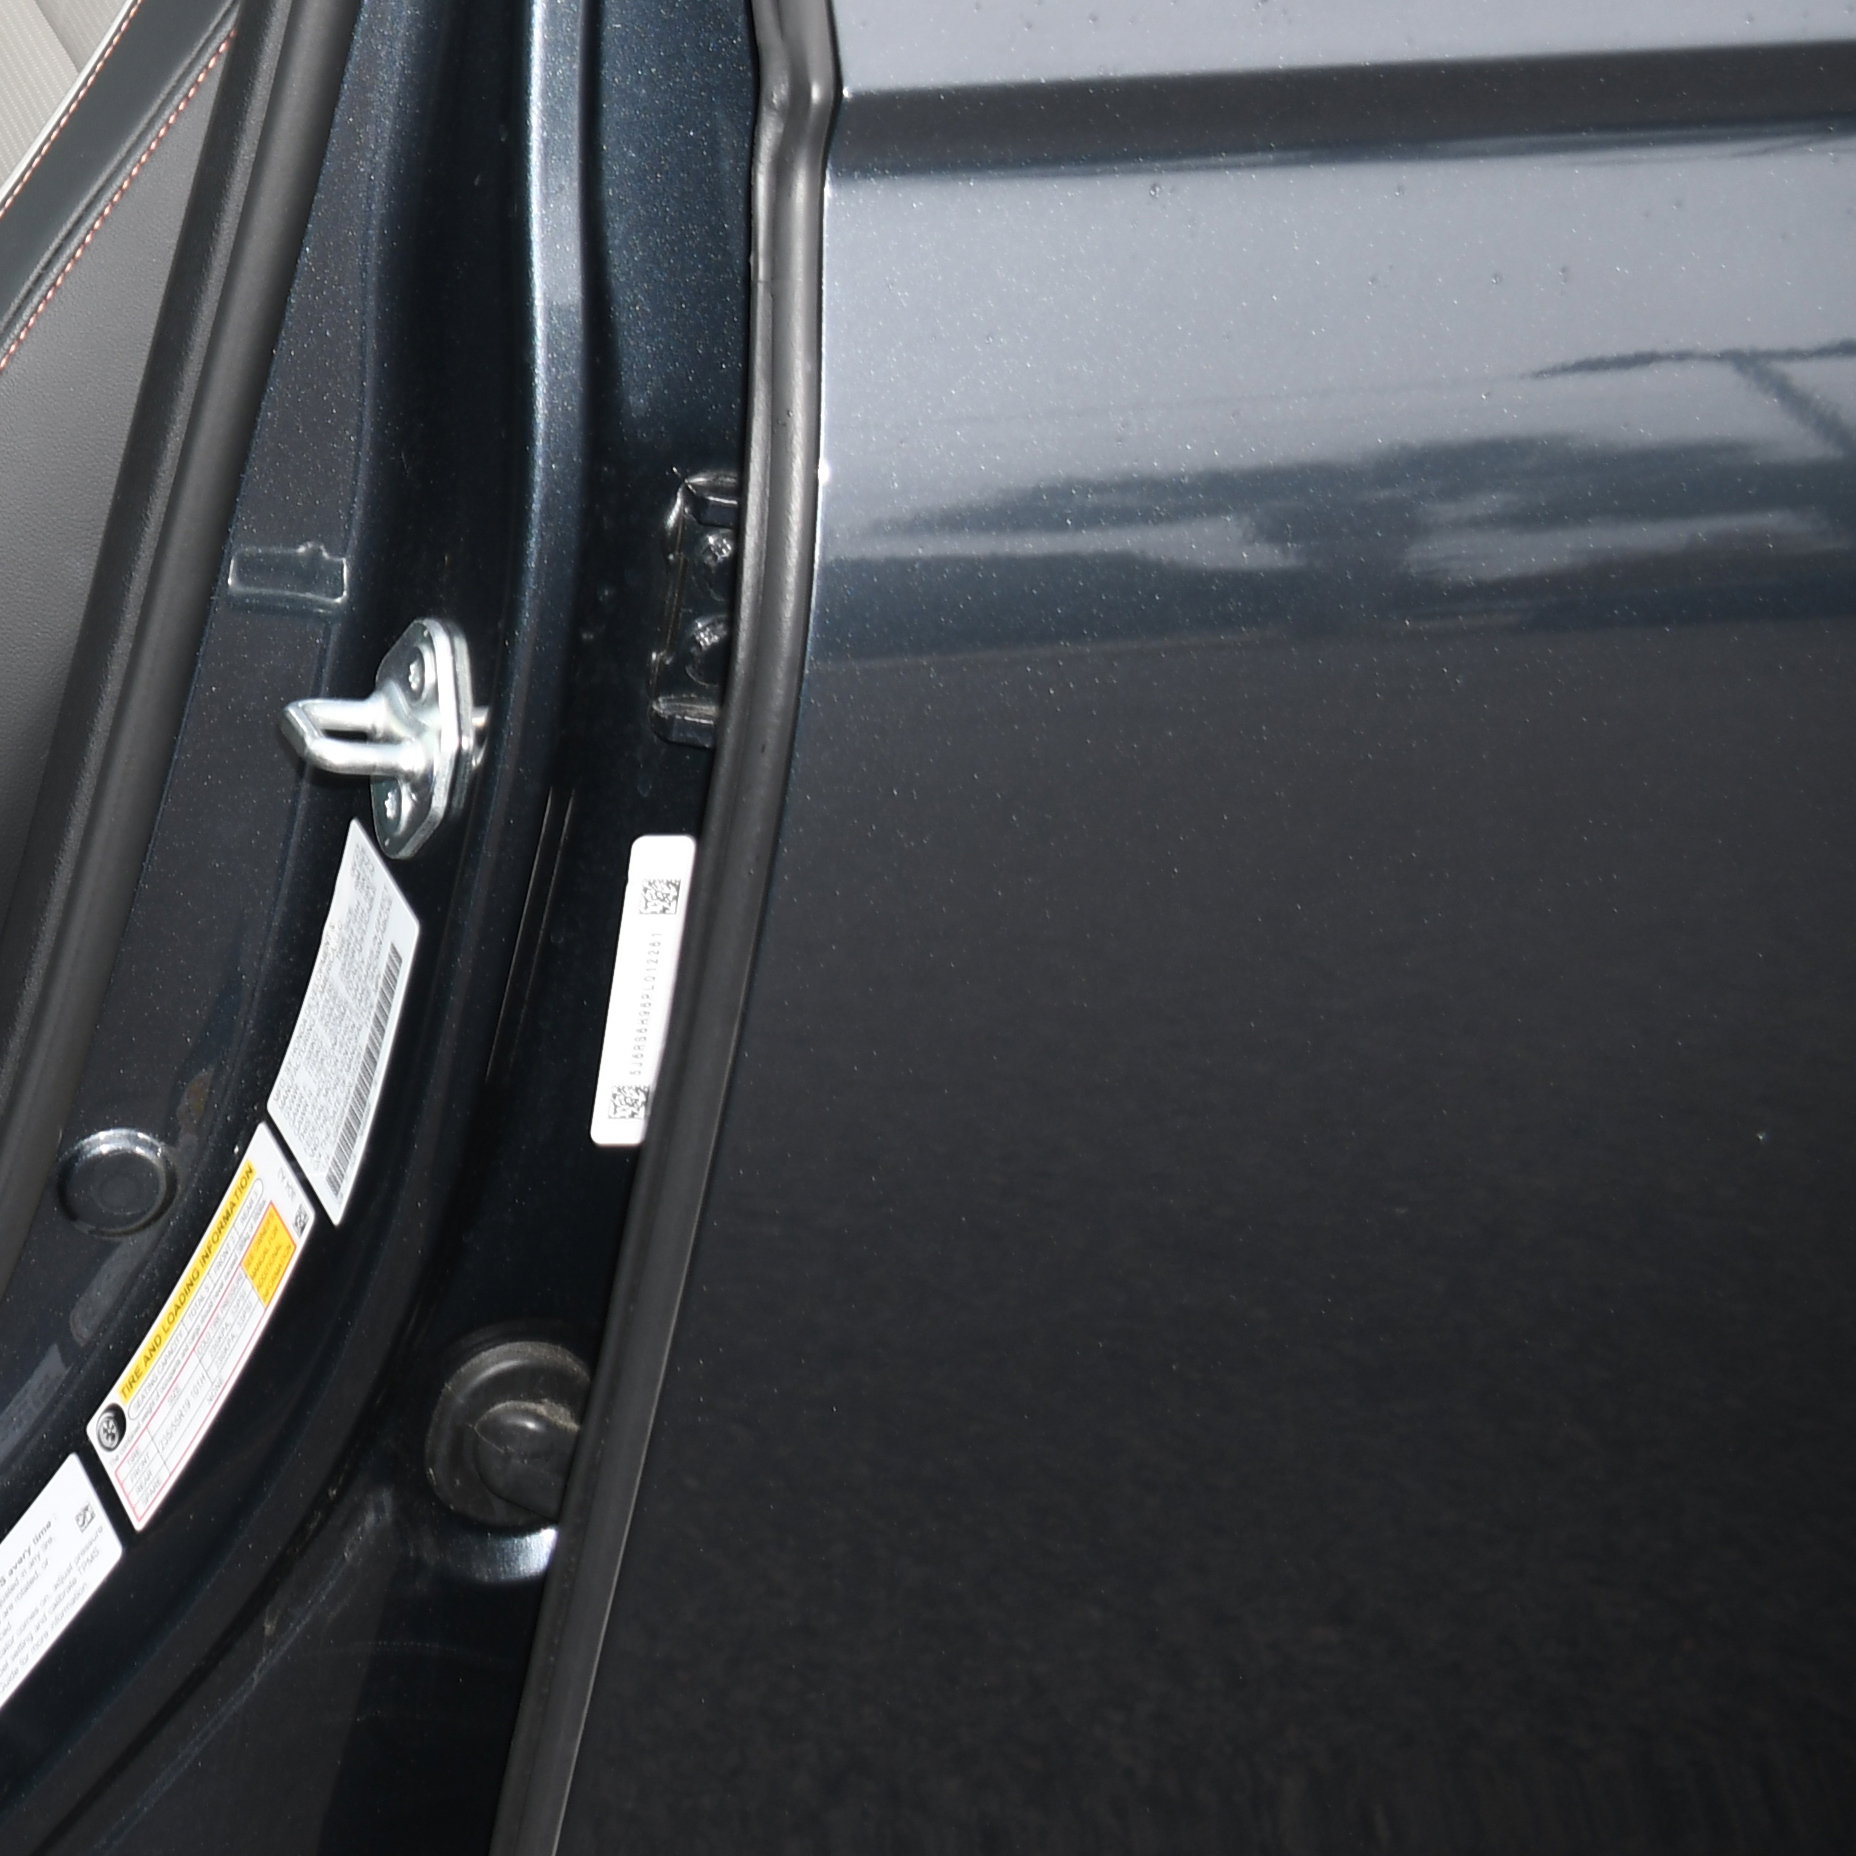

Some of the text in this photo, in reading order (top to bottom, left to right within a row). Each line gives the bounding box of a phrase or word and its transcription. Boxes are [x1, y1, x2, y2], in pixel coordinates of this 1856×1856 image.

[120, 1162, 254, 1401] TIRE AND LOADING INFORMATION
[6, 1543, 32, 1579] every
[31, 1516, 52, 1547] time
